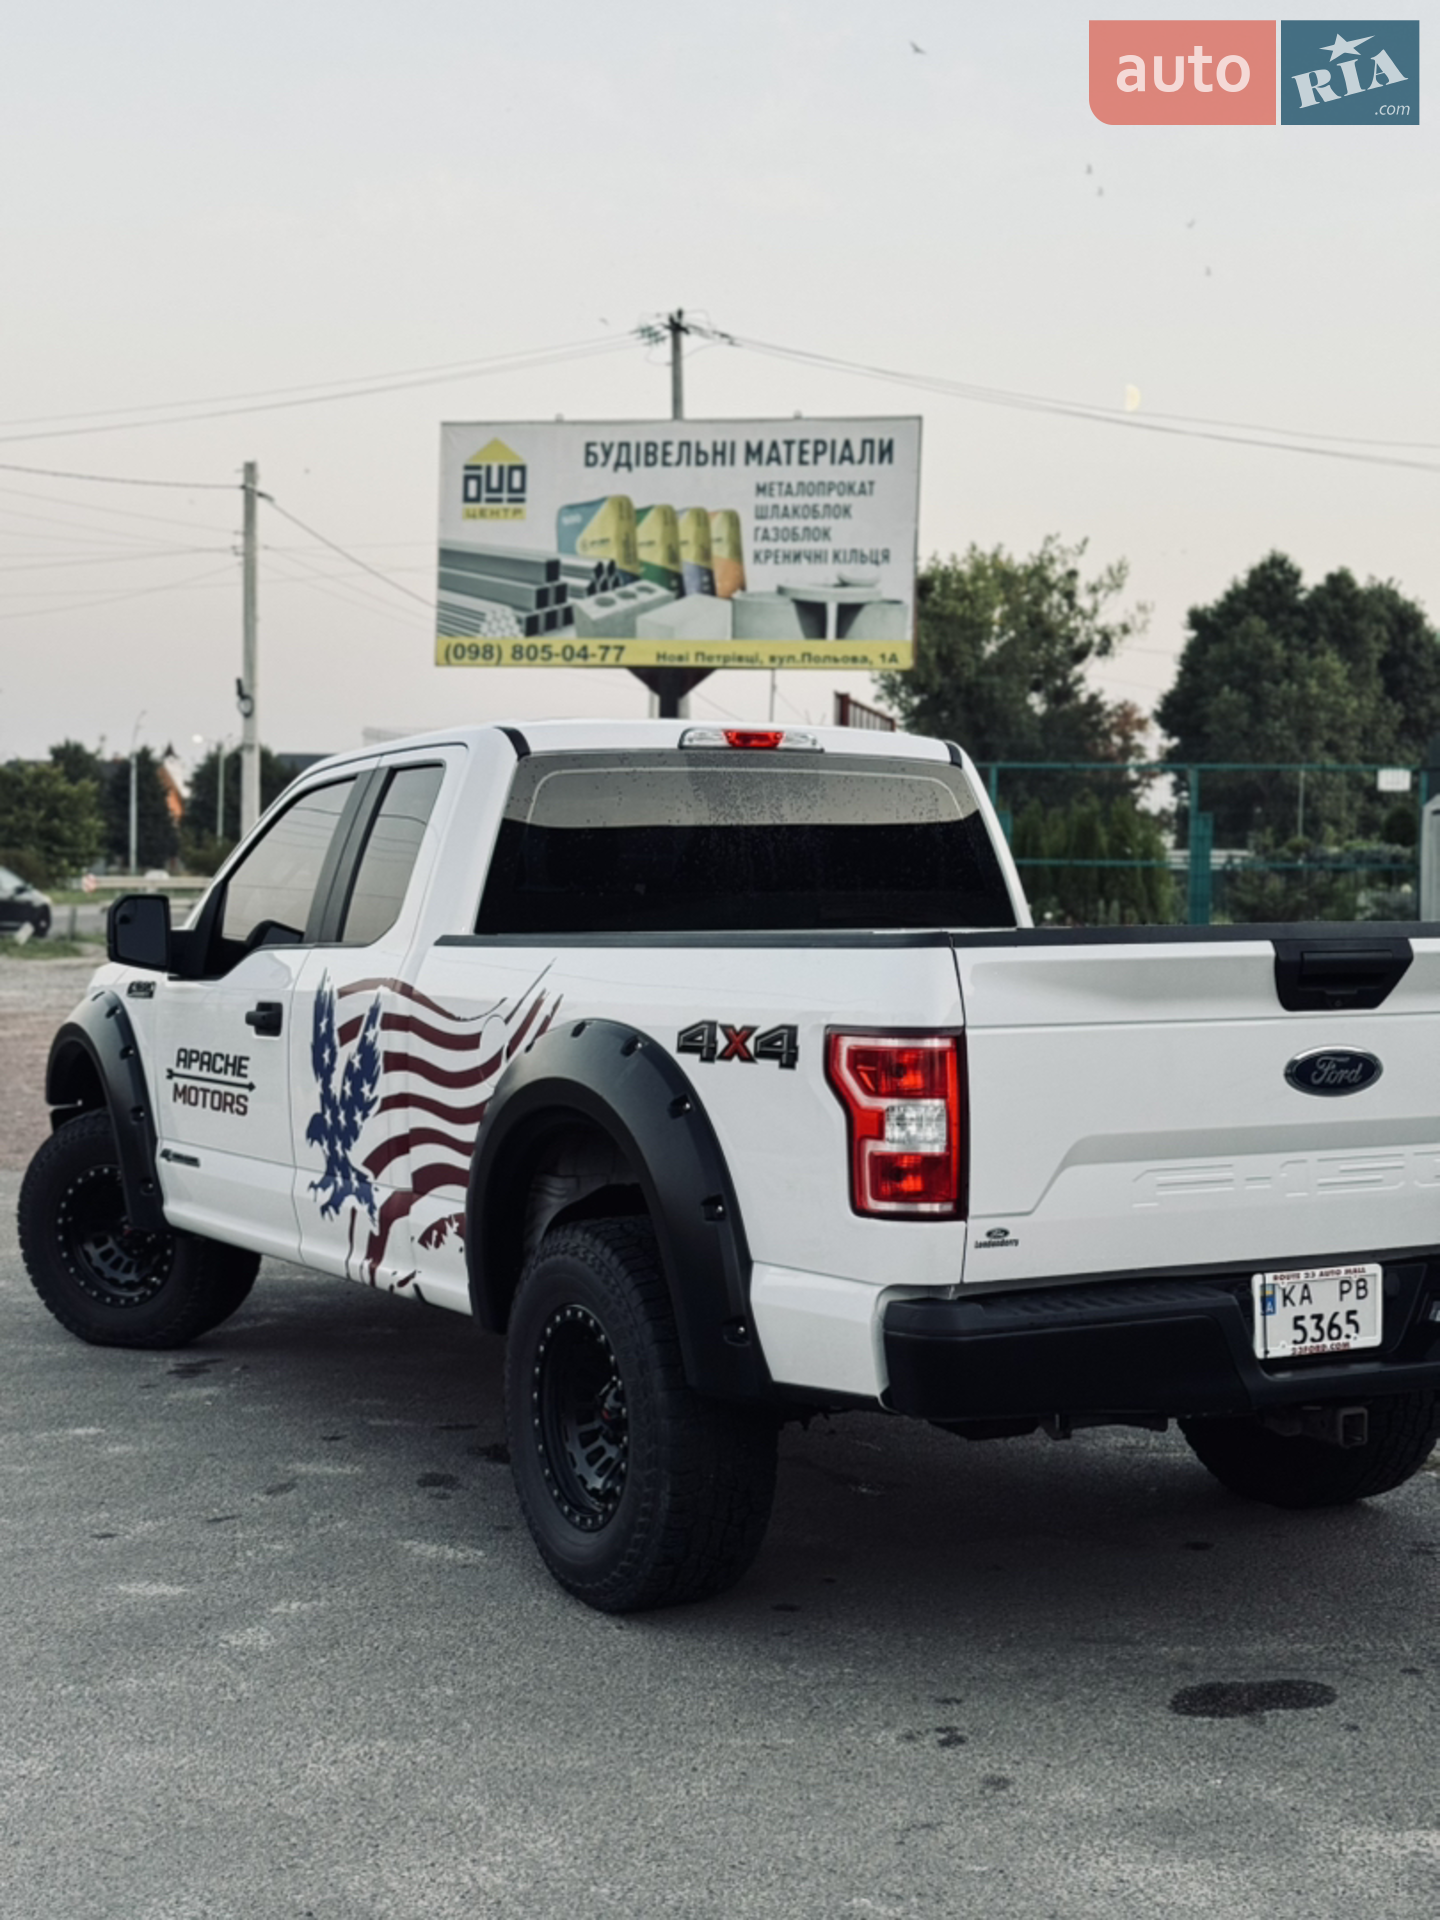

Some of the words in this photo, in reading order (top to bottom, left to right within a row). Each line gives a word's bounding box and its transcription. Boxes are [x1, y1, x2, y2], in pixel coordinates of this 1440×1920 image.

[584, 440, 736, 474] БУДІВЕЛЬНІ
[744, 438, 895, 467] МАТЕРІАЛИ
[754, 480, 876, 498] МЕТАЛОПРОКАТ
[465, 508, 524, 519] ЦЕНТР
[754, 503, 853, 520] ШЛАКОБЛОК
[753, 526, 832, 543] ГАЗОБЛОК
[832, 548, 891, 566] КІЛЬЦЯ
[444, 643, 503, 666] (098)
[511, 644, 626, 663] 805-04-77
[656, 652, 690, 664] Нові
[694, 652, 764, 667] Петрівці,
[175, 1047, 251, 1079] APACHE
[1311, 1055, 1364, 1085] Ford
[172, 1082, 249, 1117] MOTORS
[1319, 1269, 1342, 1277] AUTO
[1281, 1283, 1313, 1307] KA
[1339, 1278, 1368, 1302] PB
[1292, 1309, 1360, 1345] 5365
